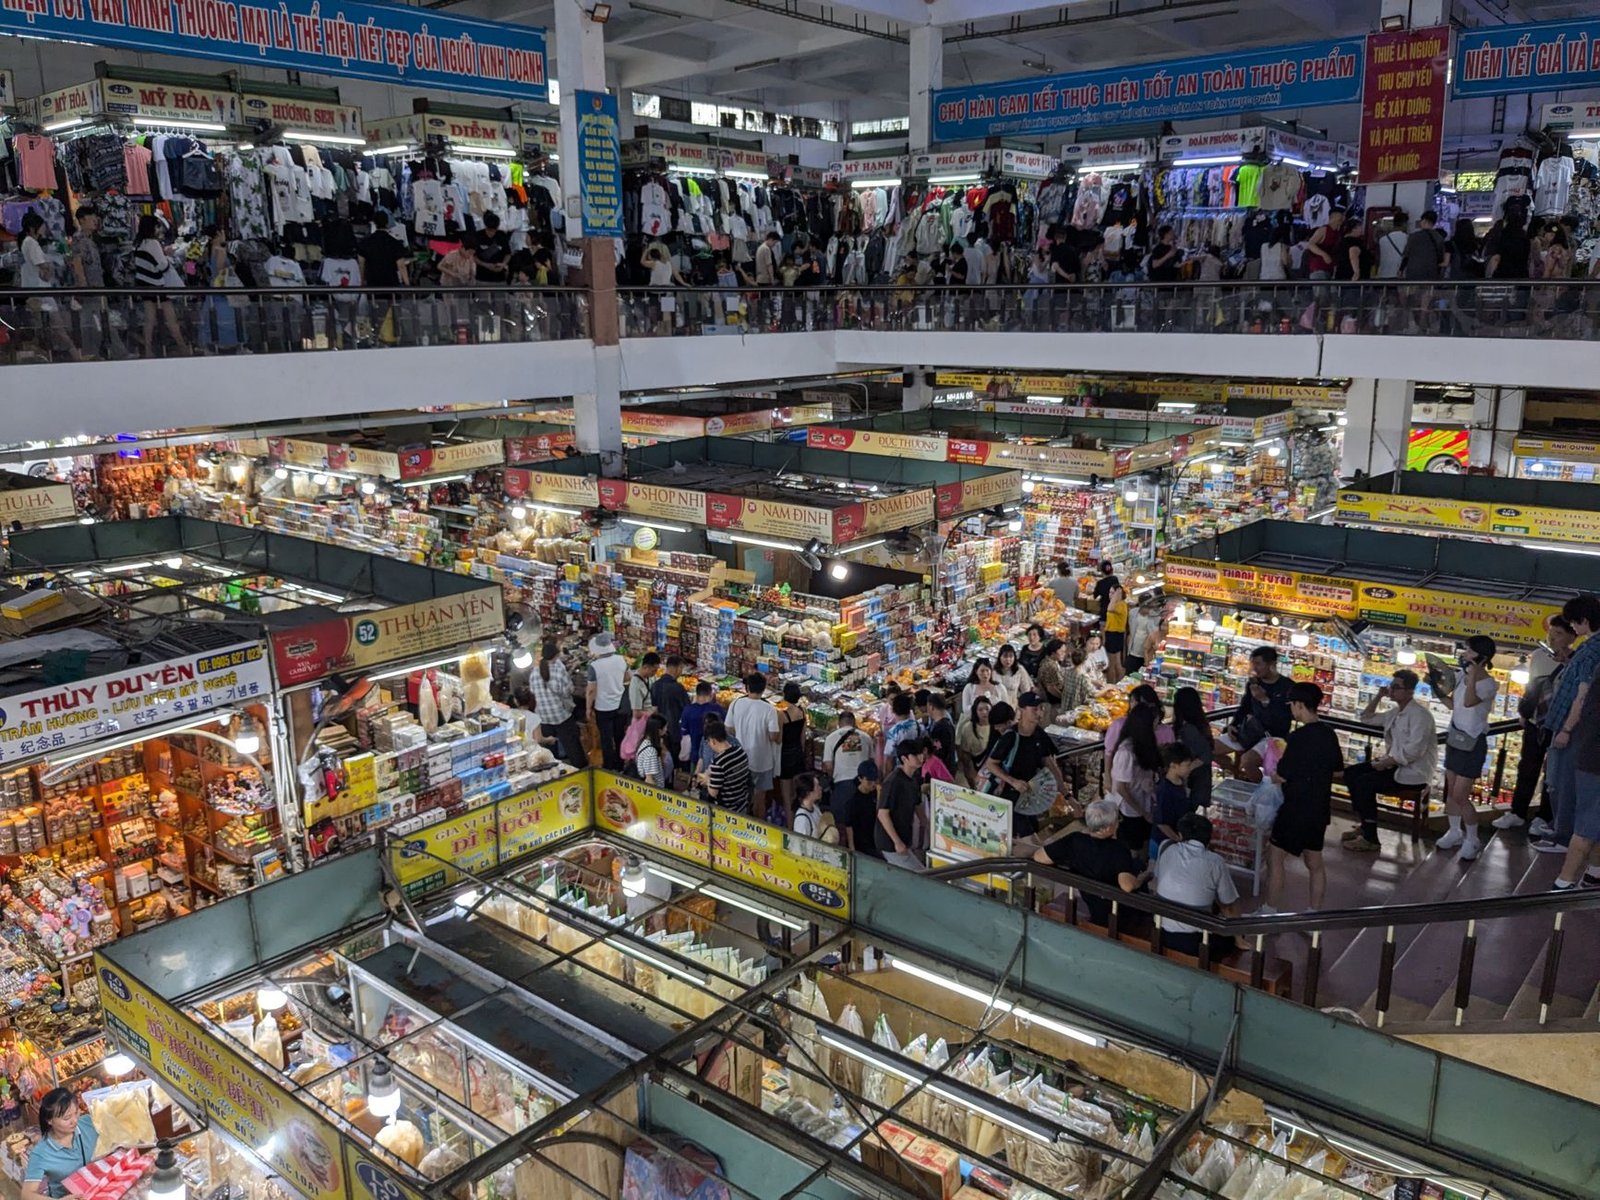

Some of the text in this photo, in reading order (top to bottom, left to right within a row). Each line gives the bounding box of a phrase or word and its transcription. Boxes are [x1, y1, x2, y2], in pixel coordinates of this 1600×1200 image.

[128, 0, 174, 34] MINH
[240, 5, 271, 55] MẠI
[273, 1, 294, 50] LÀ
[293, 1, 323, 55] THỂ
[322, 12, 358, 66] HIỆN
[358, 17, 384, 63] NÉT
[384, 28, 411, 74] ĐẸP
[412, 25, 439, 72] CỦA
[440, 34, 478, 77] NGƯỜI
[478, 42, 507, 78] KINH
[508, 49, 545, 84] DOANH
[1464, 33, 1590, 81] NIÊM YẾT GIÁ VÀ
[939, 98, 966, 124] CHỢ
[968, 94, 996, 119] HÀN
[998, 93, 1029, 116] CAM
[1032, 83, 1060, 112] KẾT
[1061, 83, 1100, 110] THỰC
[1103, 77, 1140, 107] HIỆN
[1143, 70, 1172, 100] TỐT
[1174, 74, 1199, 96] AN
[1202, 64, 1246, 93] TOÀN
[1249, 60, 1298, 90] THỰC
[1300, 47, 1356, 82] PHẨM
[1377, 73, 1394, 91] THU
[1416, 65, 1432, 87] YẾU
[139, 87, 212, 112] MỸ HÒA
[1388, 99, 1407, 118] XÂY
[1407, 97, 1431, 119] DỰNG
[1369, 120, 1433, 147] VÀ PHÁT TRIỂN
[1396, 150, 1420, 170] NƯỚC
[641, 488, 705, 508] SHOP NHI
[880, 495, 905, 514] NAM
[762, 508, 792, 521] NAM
[1386, 503, 1437, 516] NA
[360, 624, 376, 644] 52
[20, 662, 195, 719] THÙY DUYÊN
[46, 707, 99, 730] HƯƠNG
[112, 694, 145, 715] LƯU
[203, 671, 238, 695] NGHỆ
[133, 705, 158, 726] 진주
[226, 681, 260, 701] 기념품
[20, 732, 66, 755] 纪念品
[636, 785, 654, 798] CÁC
[435, 826, 461, 843] GIA
[463, 818, 478, 832] VỊ
[724, 814, 738, 826] CÁ
[745, 821, 768, 836] TÔM
[544, 829, 559, 843] CÁC
[737, 861, 757, 878] VỊ
[760, 871, 794, 891] GIA
[812, 893, 832, 906] LÔ
[135, 992, 161, 1018] GIA
